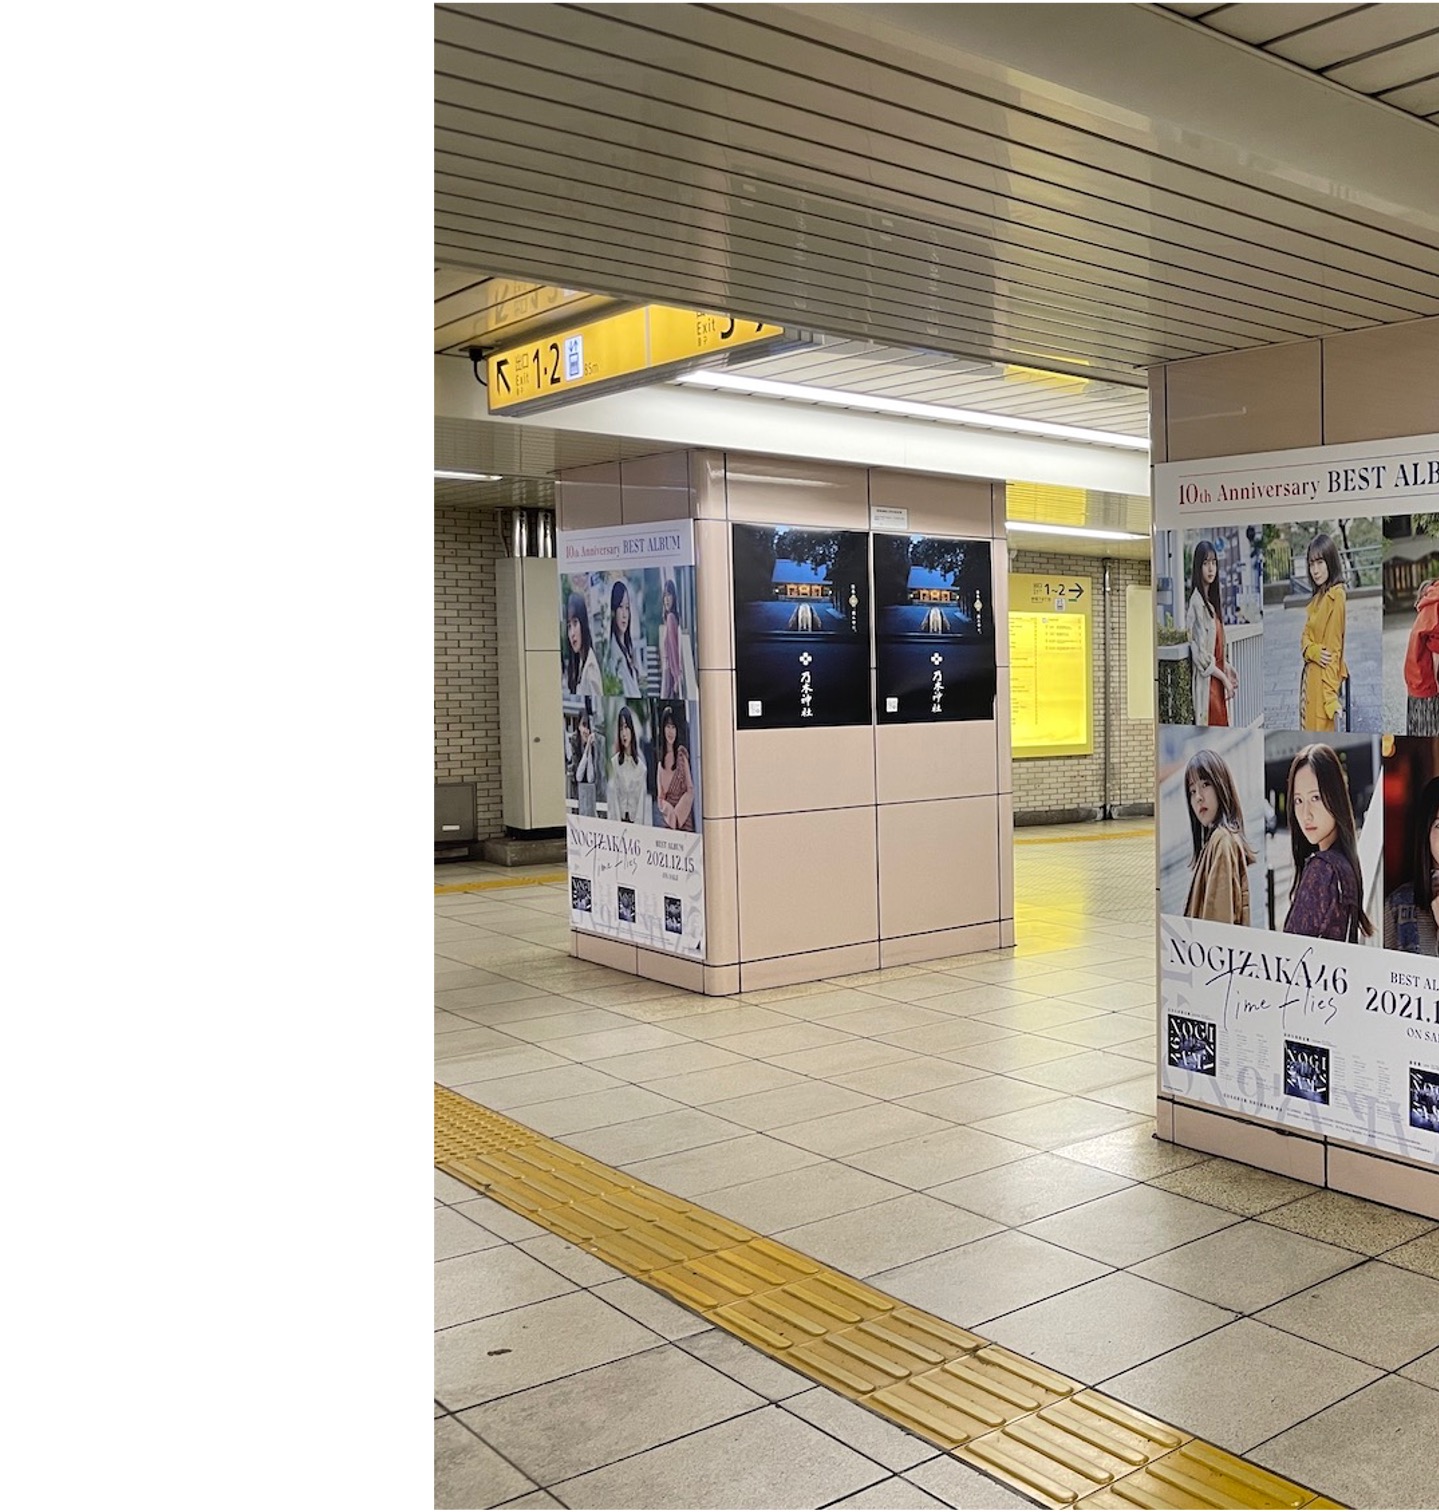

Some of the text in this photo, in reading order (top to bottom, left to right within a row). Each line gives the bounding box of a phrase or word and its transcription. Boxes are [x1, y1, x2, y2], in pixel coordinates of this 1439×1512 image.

[696, 317, 716, 336] Exit
[515, 353, 529, 372] 出口
[1178, 482, 1213, 506] 10th
[1216, 477, 1321, 504] Anniversary
[1327, 465, 1387, 494] BEST
[580, 544, 621, 558] Anniversary
[622, 538, 646, 555] BEST
[647, 535, 681, 553] ALBUM
[800, 670, 814, 718] 乃木神社
[931, 669, 945, 714] 乃木神社
[646, 849, 695, 874] 2021.12.15
[1169, 938, 1348, 995] NOGIZAKA46
[1390, 971, 1421, 988] BEST
[1406, 1026, 1422, 1040] ON
